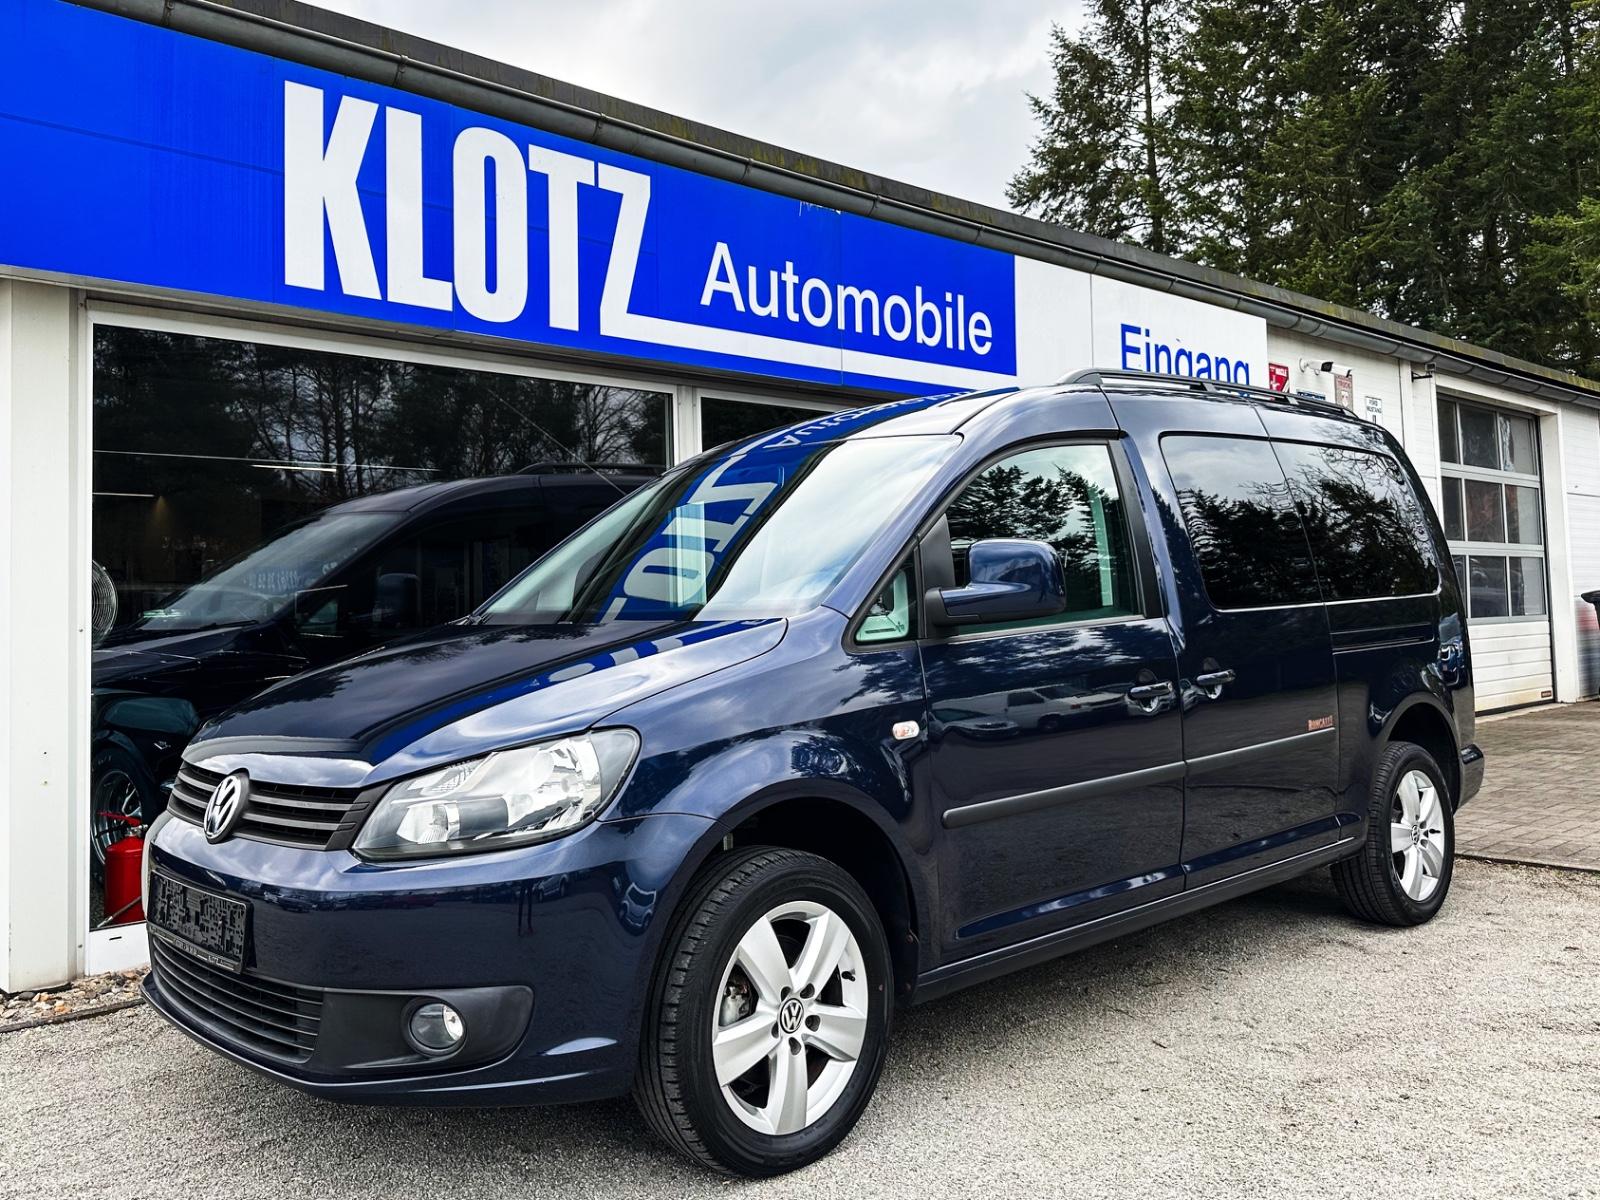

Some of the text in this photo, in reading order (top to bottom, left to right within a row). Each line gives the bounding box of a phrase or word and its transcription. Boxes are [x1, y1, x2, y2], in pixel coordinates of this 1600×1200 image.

[284, 80, 993, 355] KLOTZ Automobile
[1121, 323, 1250, 386] Eingang
